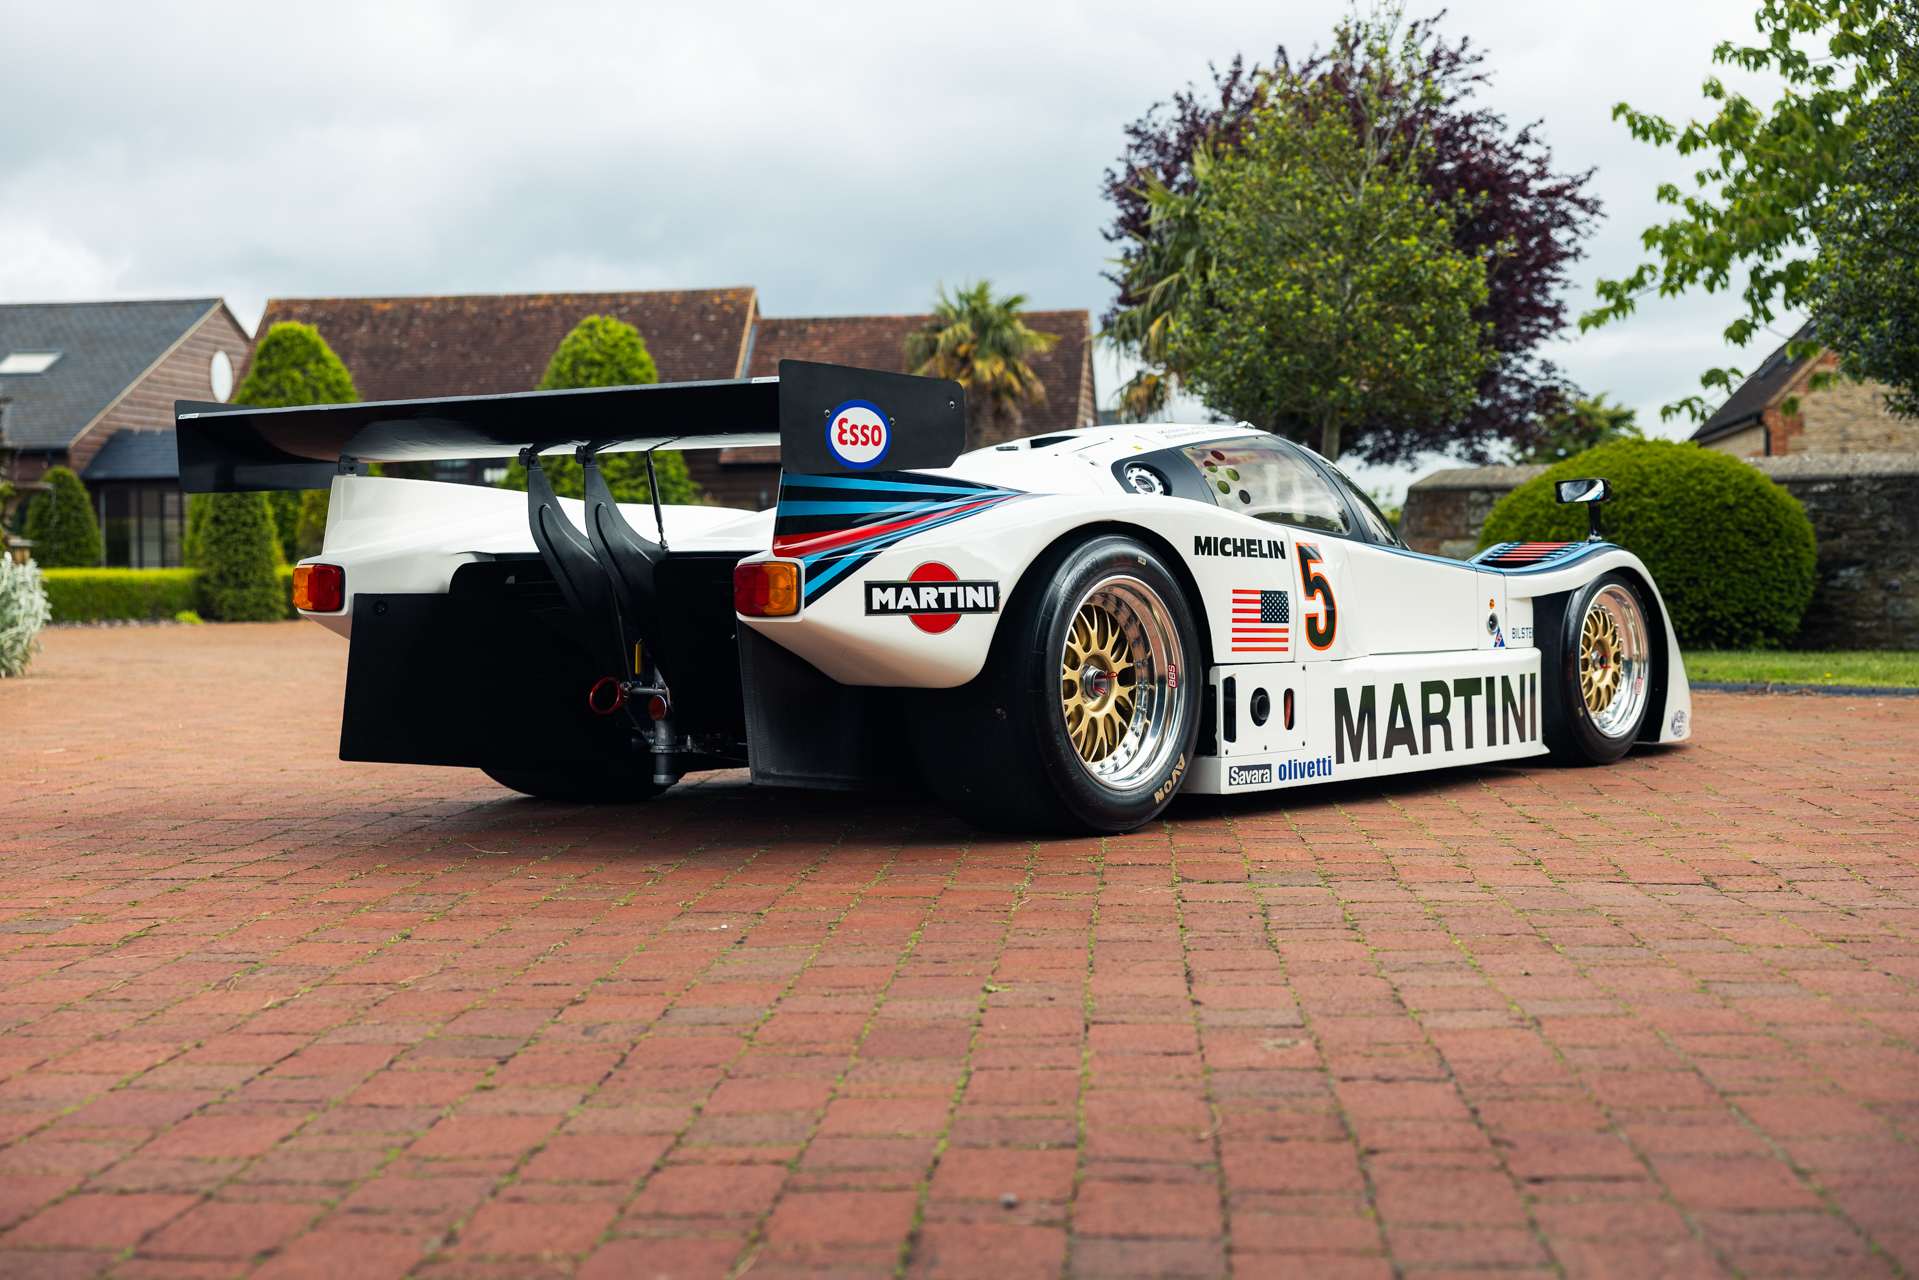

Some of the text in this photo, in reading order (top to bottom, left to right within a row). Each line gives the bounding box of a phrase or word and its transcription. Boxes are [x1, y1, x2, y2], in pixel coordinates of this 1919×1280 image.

[1194, 535, 1286, 559] MICHELIN
[871, 586, 995, 610] MARTINI
[1296, 541, 1337, 651] 5
[1168, 664, 1176, 688] BBS
[1334, 673, 1537, 765] MARTINI
[1154, 752, 1185, 804] AVON
[1230, 766, 1271, 785] Savara
[1278, 756, 1332, 781] olivetti
